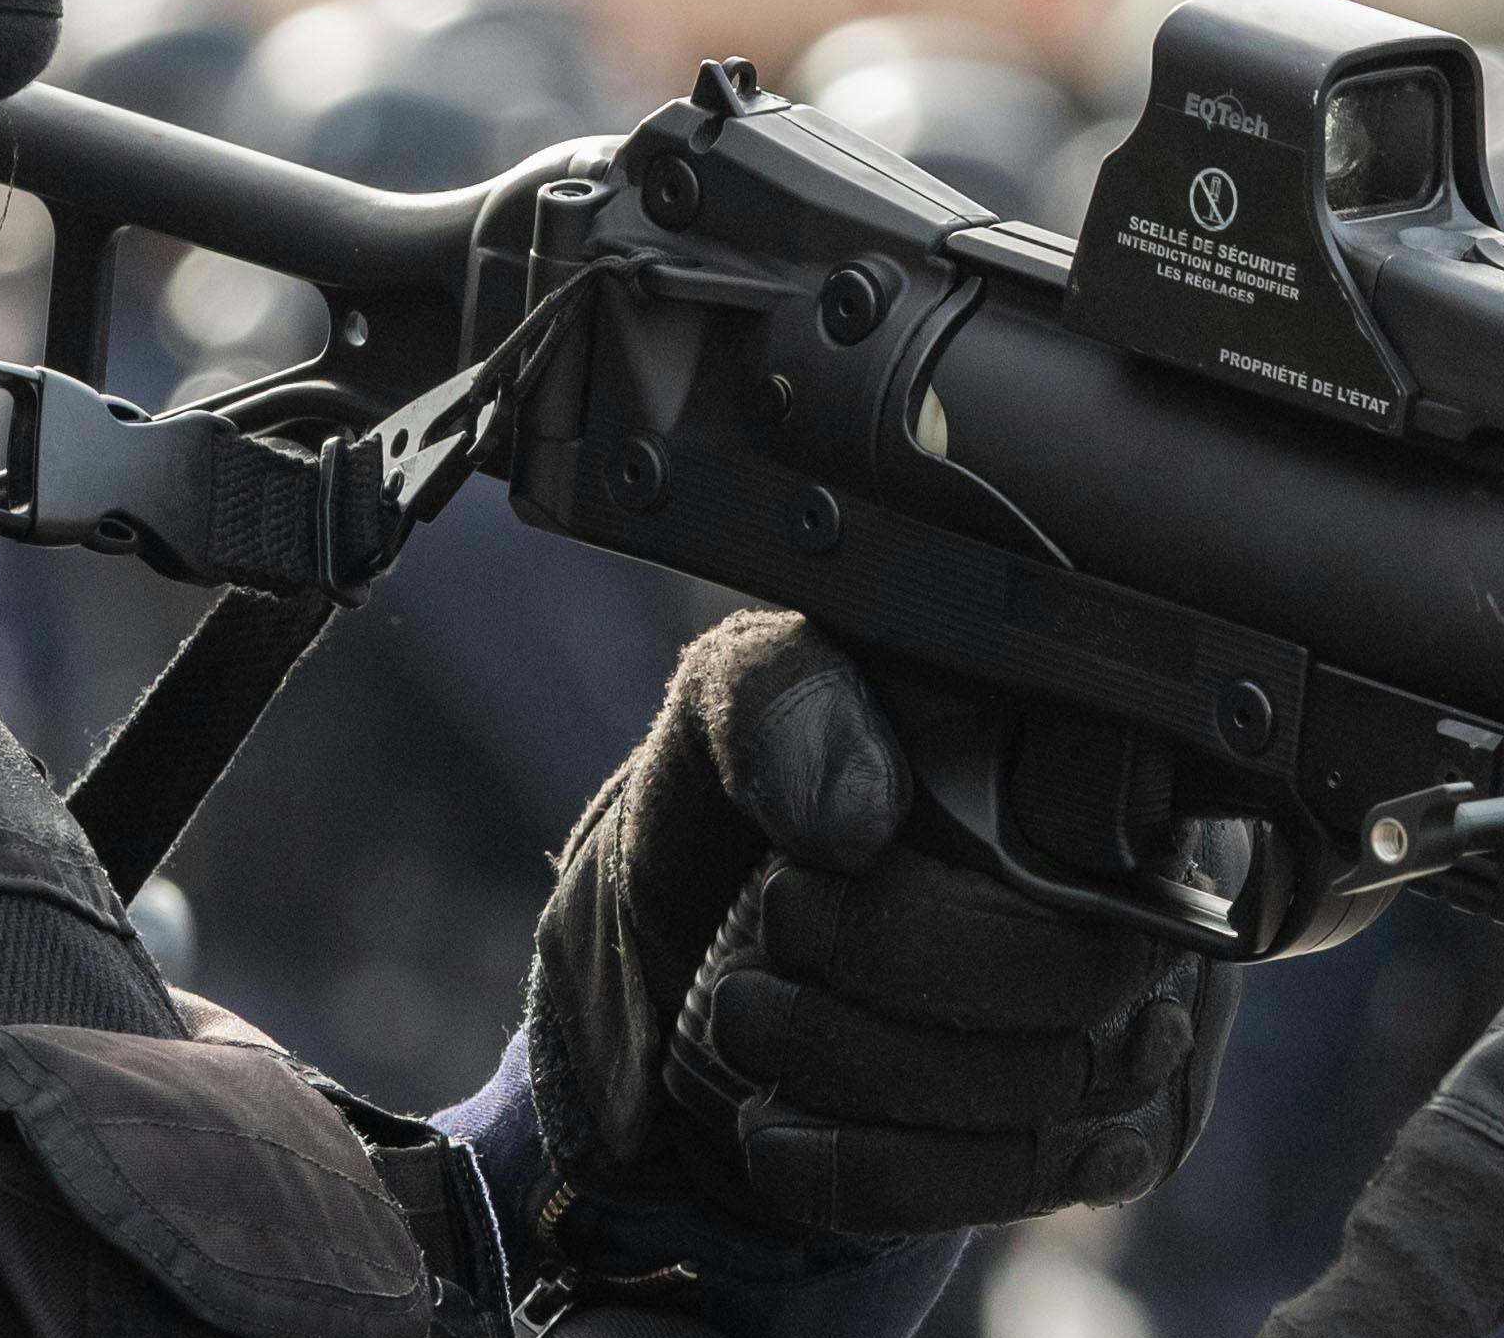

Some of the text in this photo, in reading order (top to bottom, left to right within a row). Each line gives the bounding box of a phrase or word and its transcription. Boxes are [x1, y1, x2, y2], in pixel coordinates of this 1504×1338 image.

[1117, 231, 1300, 301] INTERDICTION DE MODIFIER
[1128, 215, 1297, 282] SCELLÉ DE SÉCURITÉ
[1156, 262, 1255, 305] LES RÉGLAGES
[1219, 348, 1390, 415] PROPRIÉTÉ DE L'ÉTAT
